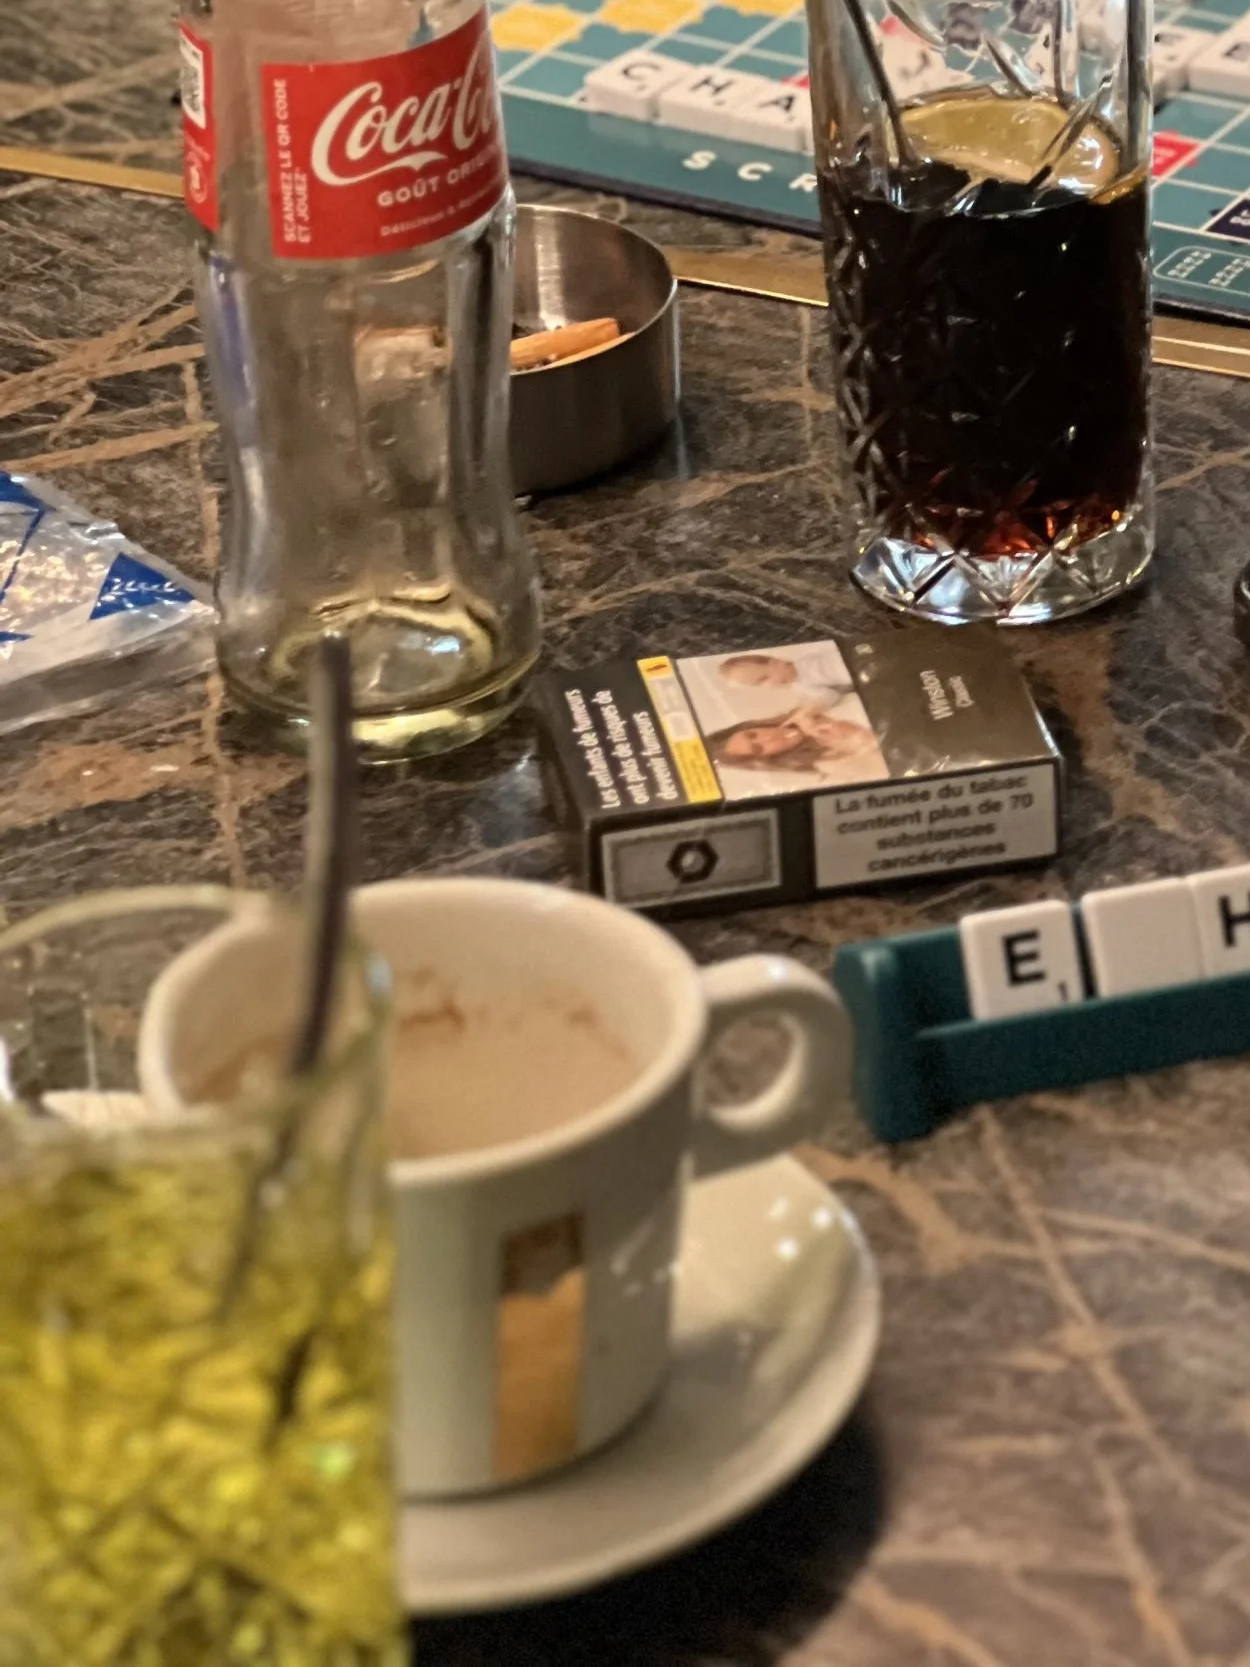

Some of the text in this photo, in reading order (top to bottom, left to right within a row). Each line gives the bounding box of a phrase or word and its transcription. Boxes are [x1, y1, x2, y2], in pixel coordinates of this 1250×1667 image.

[273, 78, 297, 243] SCANNEZ LE QR CODE
[682, 149, 819, 194] SCR
[376, 175, 441, 208] GOÛT
[296, 224, 312, 243] ET
[920, 669, 955, 721] Winston
[564, 688, 621, 809] Les enfants de fumeurs
[610, 742, 634, 758] de
[834, 775, 1028, 815] La fumée du tabac
[836, 791, 1034, 835] contient plus de 70
[875, 821, 997, 851] substances
